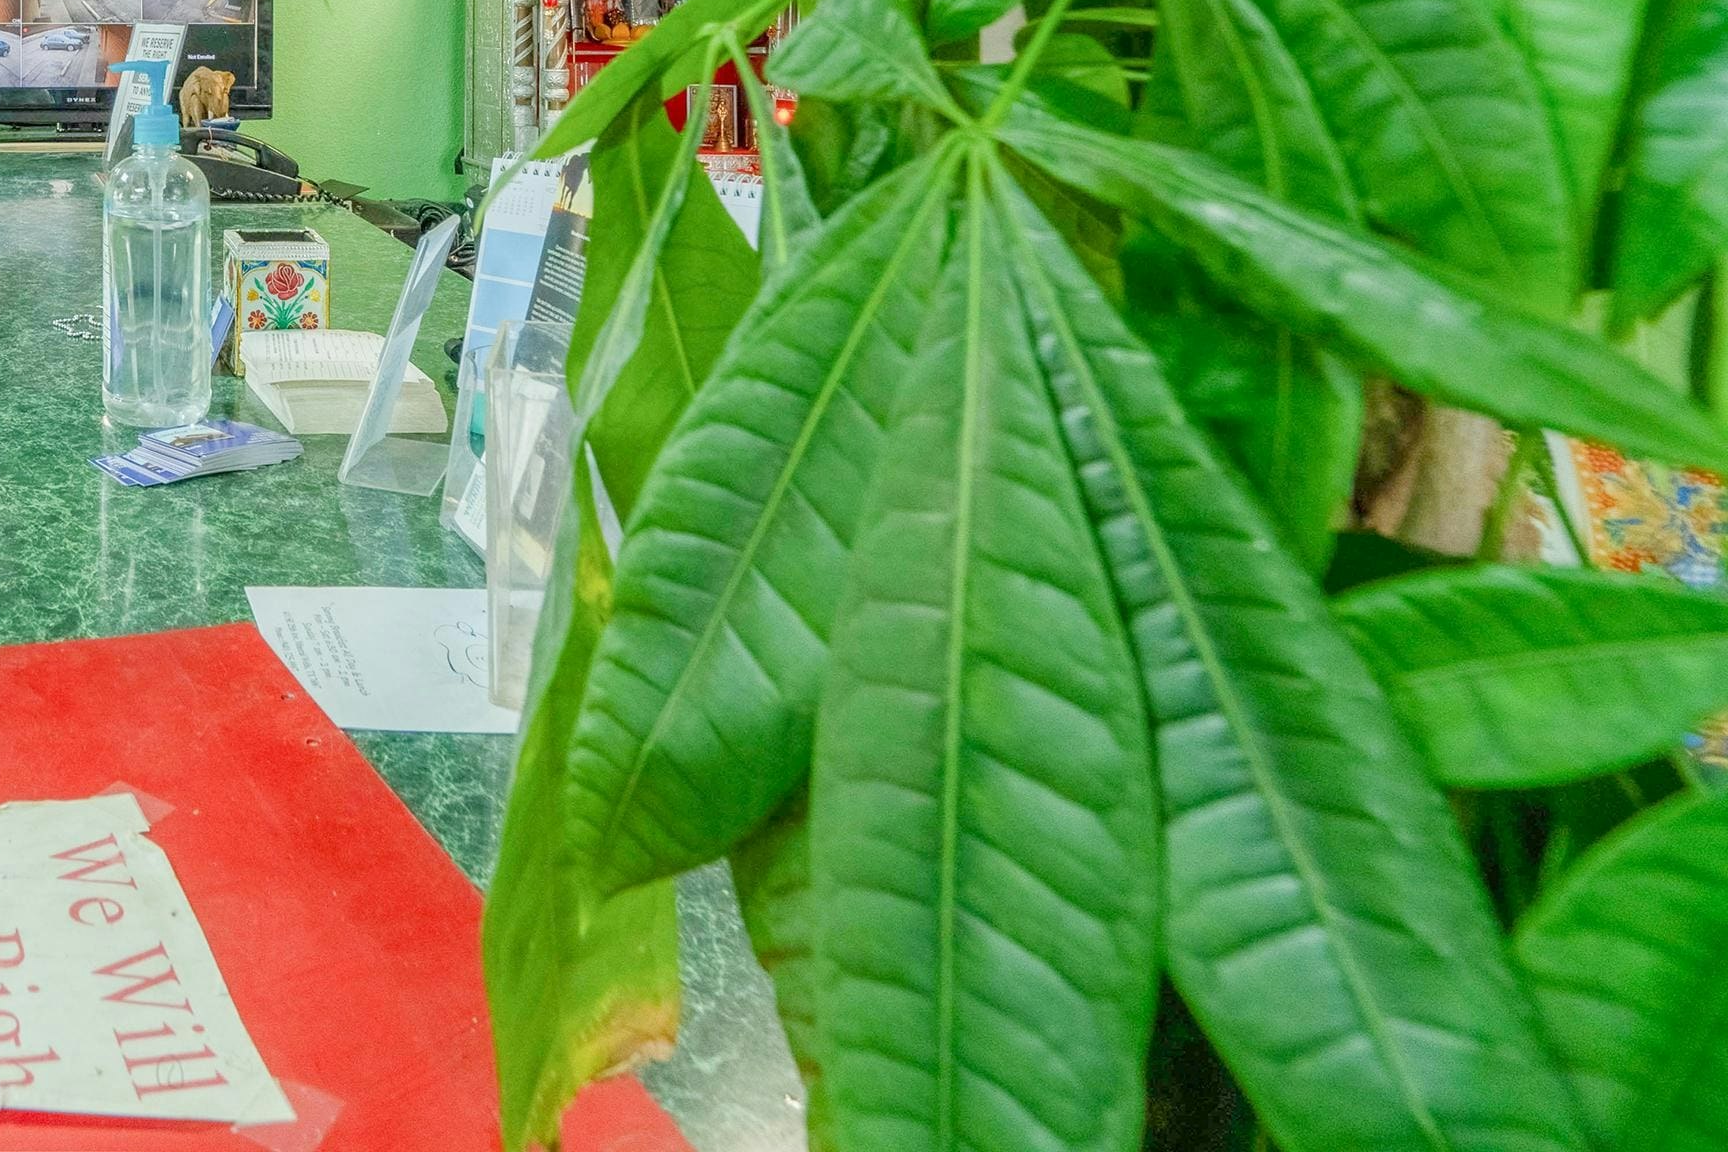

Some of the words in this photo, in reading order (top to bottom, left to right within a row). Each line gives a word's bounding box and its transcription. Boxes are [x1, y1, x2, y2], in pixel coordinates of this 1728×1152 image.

[142, 38, 150, 48] WE
[152, 38, 174, 49] RESERVE
[144, 49, 152, 58] THE
[153, 50, 168, 59] RIGHT
[49, 833, 138, 927] We
[91, 941, 229, 1102] Will
